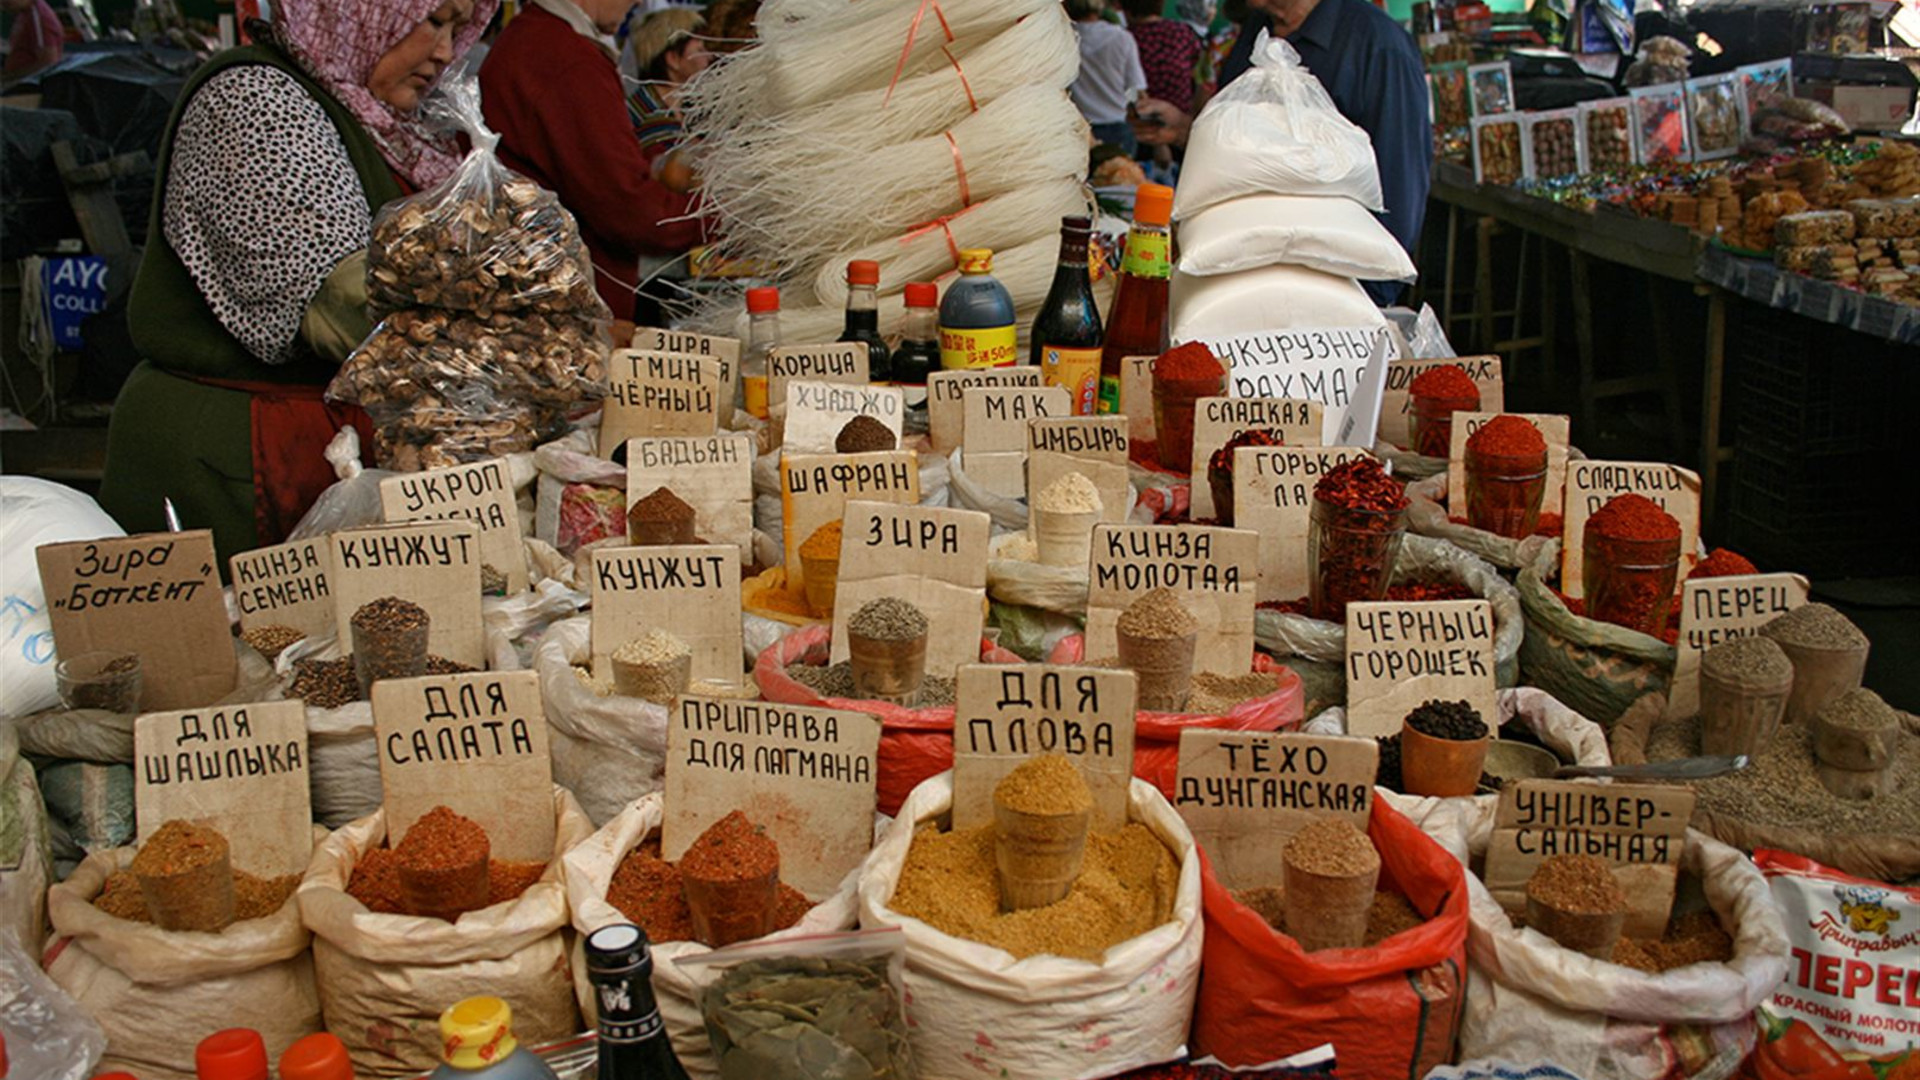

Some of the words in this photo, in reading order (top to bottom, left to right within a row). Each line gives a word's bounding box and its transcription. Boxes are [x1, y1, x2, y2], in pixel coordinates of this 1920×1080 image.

[53, 294, 107, 313] COLL
[654, 333, 710, 355] ЗИРА
[627, 355, 701, 384] ТМИН
[771, 351, 855, 376] КОРИЦА
[610, 380, 712, 413] ЧЁРНЫЙ
[797, 386, 896, 415] ХУАДЖО
[985, 394, 1048, 420] МАК
[1207, 401, 1309, 425] СЛАДКАЯ
[642, 440, 738, 467] БАДЬЯН
[1032, 425, 1126, 452] ИМБИРЬ
[788, 463, 909, 494] ШАФРАН
[1256, 453, 1366, 475] ГОРЬК
[401, 464, 503, 512] УКРОП
[340, 534, 471, 569] КУНЖУТ
[866, 515, 958, 554] ЗИРА
[1107, 531, 1211, 559] КИНЗА
[75, 541, 174, 581] Зира
[237, 544, 319, 583] КИНЗА
[597, 556, 724, 591] КУНЖУТ
[1097, 563, 1239, 593] МОЛОТАЯ
[239, 573, 329, 614] СЕМЕНА
[1694, 586, 1789, 620] ПЕРЕЦ
[1357, 605, 1488, 643] ЧЕРНЫЙ
[1350, 648, 1487, 680] ГОРОШЕК
[425, 682, 508, 722] ДЛЯ
[997, 672, 1099, 713] ДЛЯ
[176, 709, 252, 746] ДЛЯ
[682, 700, 839, 743] ПРИПРАВА
[968, 718, 1114, 757] ПЛОВА
[387, 718, 533, 764] САЛАТА
[1220, 740, 1328, 775] ТЁХО
[144, 741, 302, 785] ШАШЛЫКА
[687, 739, 744, 771] ДЛЯ
[754, 746, 870, 784] ЛАГМАНА
[1176, 777, 1367, 812] ДУНГАНСКАЯ
[1515, 788, 1672, 830] УНИВЕР-
[1516, 827, 1670, 864] САЛЬНАЯ
[1773, 993, 1852, 1024] КРАСНЫЙ
[1823, 1024, 1884, 1046] ЖГУЧИЙ
